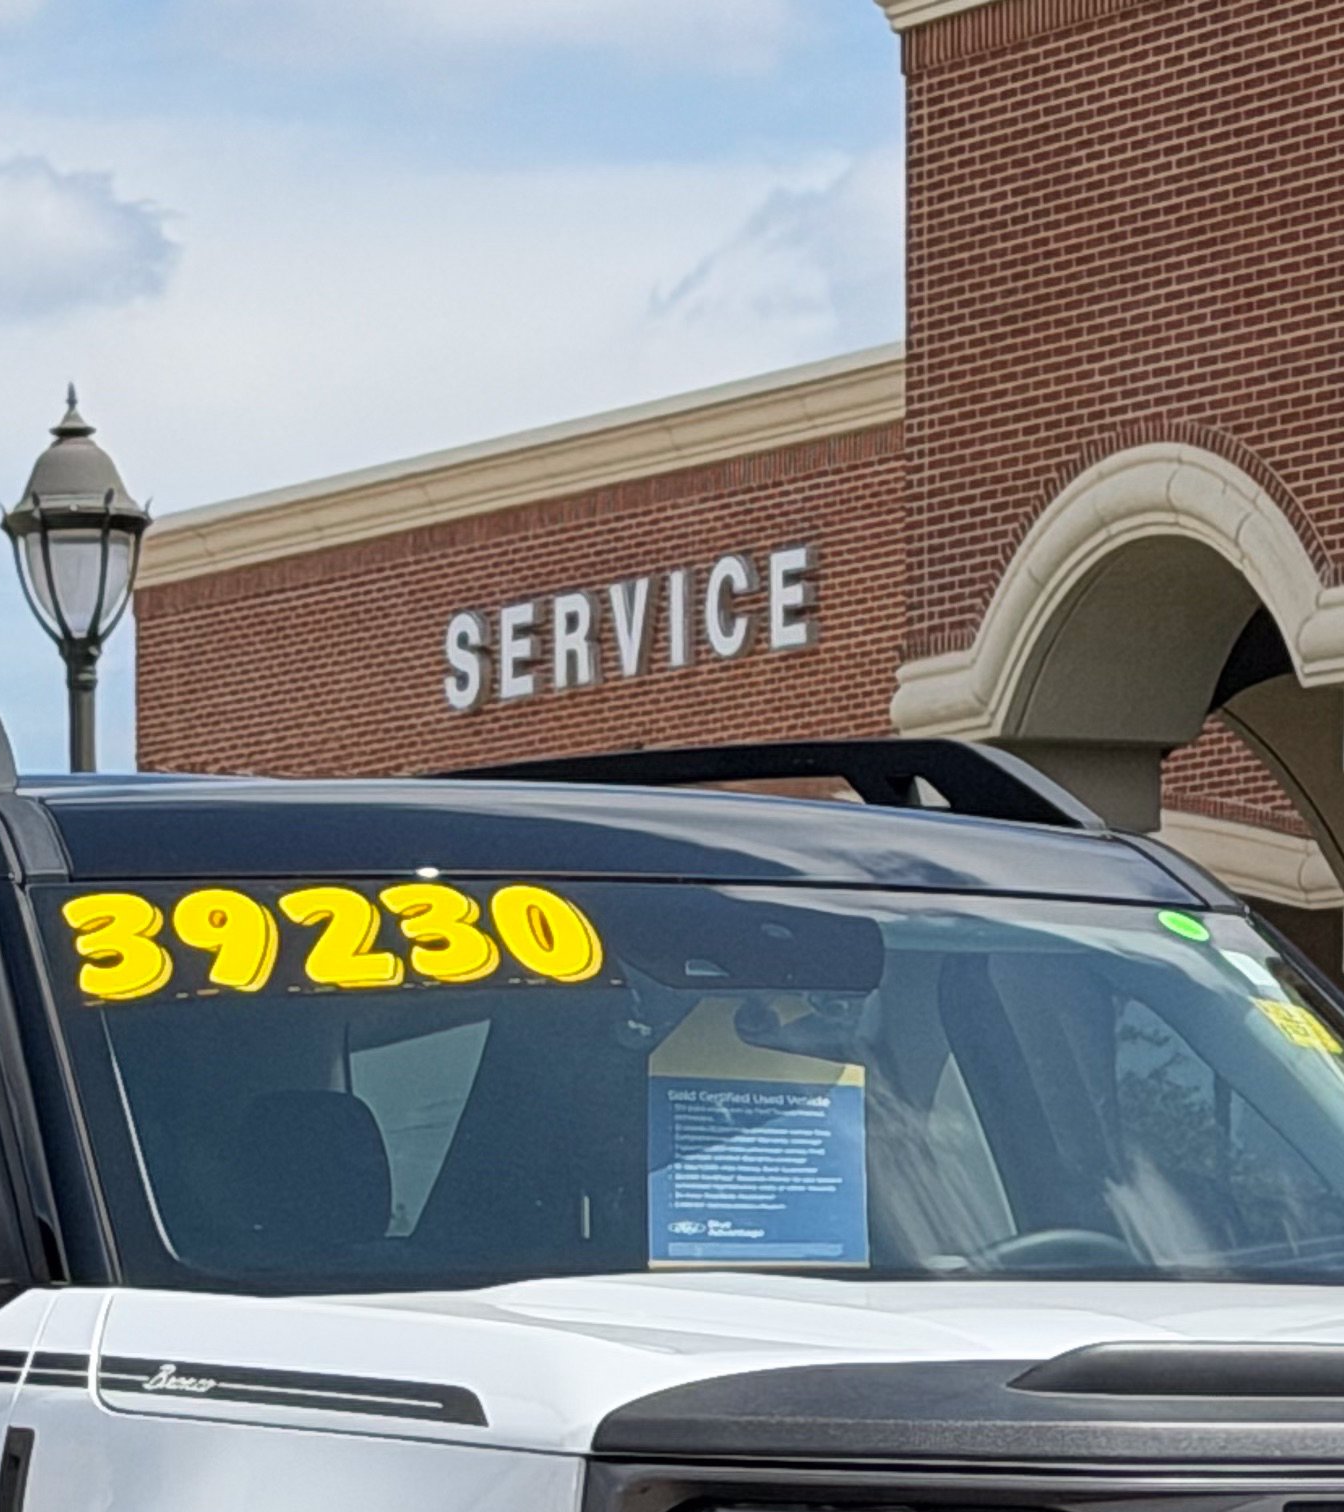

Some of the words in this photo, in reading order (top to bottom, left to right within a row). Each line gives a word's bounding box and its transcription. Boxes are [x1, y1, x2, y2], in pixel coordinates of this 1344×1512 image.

[444, 545, 816, 711] SERVICE
[62, 883, 604, 1000] 39230
[699, 1090, 751, 1104] Certified
[752, 1092, 785, 1106] Used
